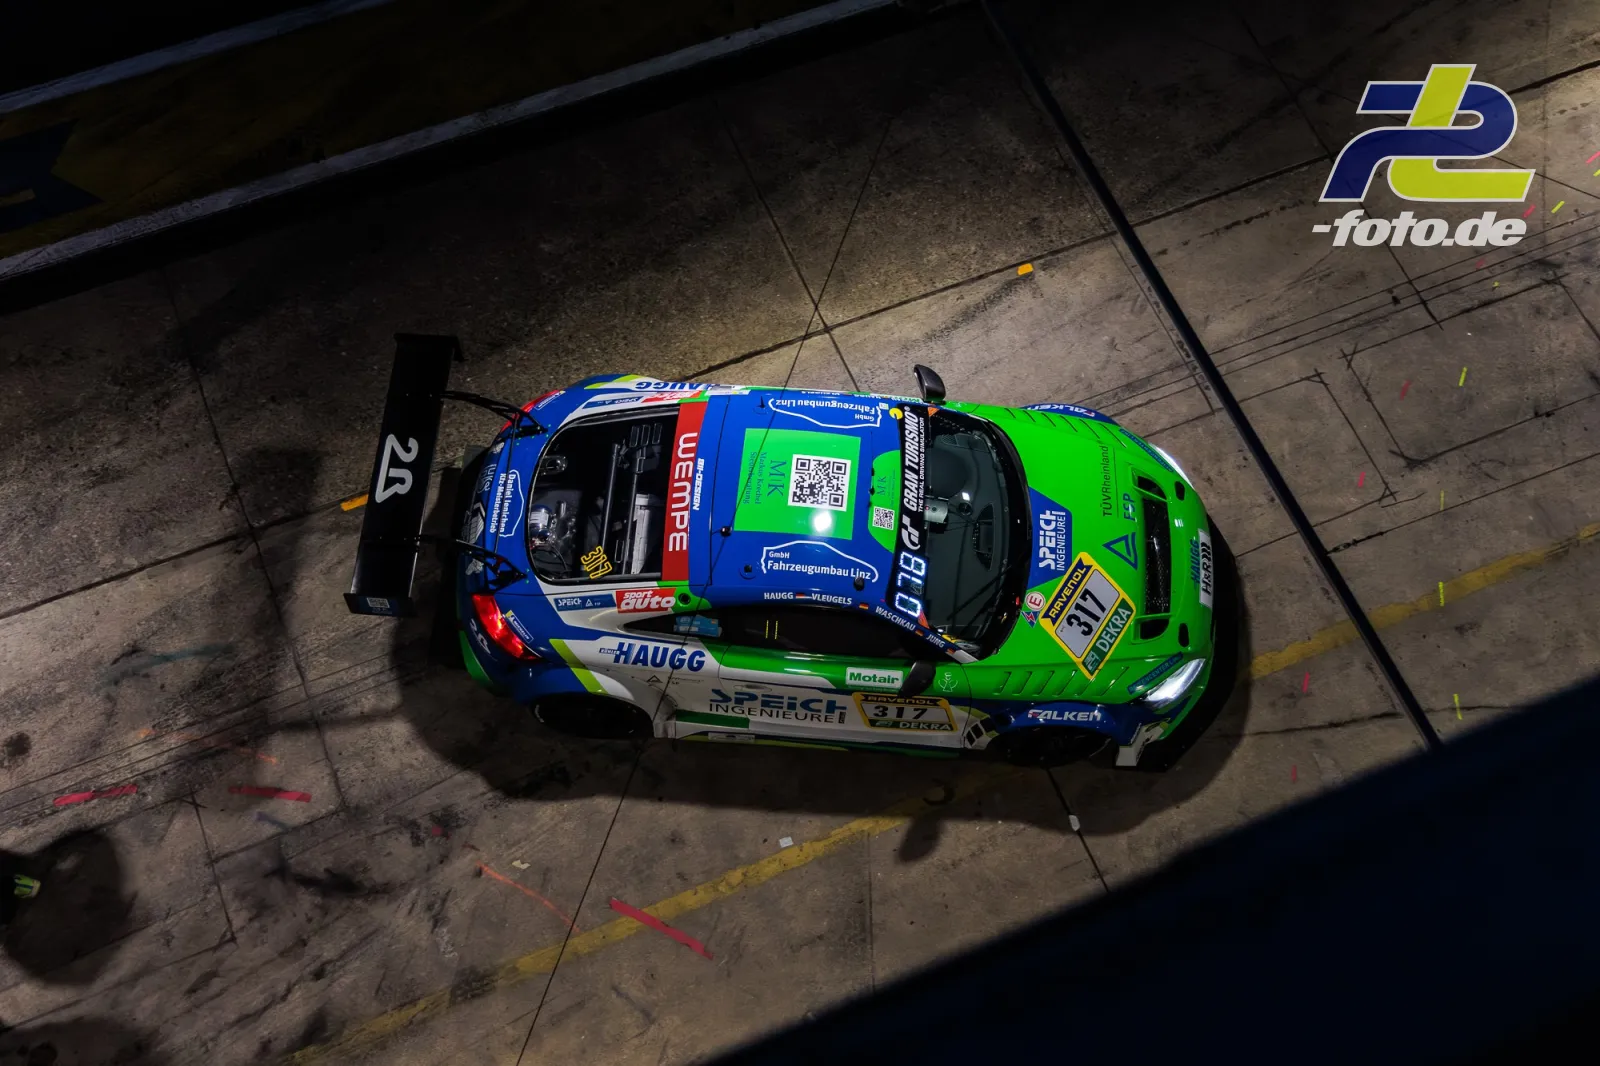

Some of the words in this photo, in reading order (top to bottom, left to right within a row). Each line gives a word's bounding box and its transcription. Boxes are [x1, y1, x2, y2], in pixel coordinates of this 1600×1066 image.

[776, 399, 796, 408] Linz
[798, 399, 875, 415] Fahrzeugumbau
[854, 413, 875, 422] GmbH
[505, 474, 516, 498] Daniel
[668, 432, 698, 552] WEMPE
[904, 468, 918, 512] GRAN
[490, 473, 507, 533] Kfz-Meisterbetrieb
[1123, 492, 1136, 521] FSP
[1038, 509, 1056, 570] SPEICH
[1052, 510, 1066, 571] INGENIEUREI
[580, 545, 613, 580] 317
[768, 550, 790, 559] GmbH
[767, 560, 849, 577] Fahrzeugumbau
[850, 568, 871, 580] Linz
[620, 596, 676, 610] auto
[623, 590, 654, 599] sport
[763, 592, 794, 600] HAUGG
[811, 593, 853, 605] VLEUGELS
[1048, 567, 1087, 619] RAVENOL
[875, 605, 916, 631] WASCHKAU
[1066, 588, 1106, 637] 317
[926, 633, 946, 648] JUNG
[1097, 606, 1132, 654] DEKRA
[613, 642, 706, 672] HAUGG
[850, 672, 899, 684] Motair
[873, 705, 928, 720] 317
[1027, 708, 1102, 721] FALKEN
[900, 722, 951, 731] DEKRA
